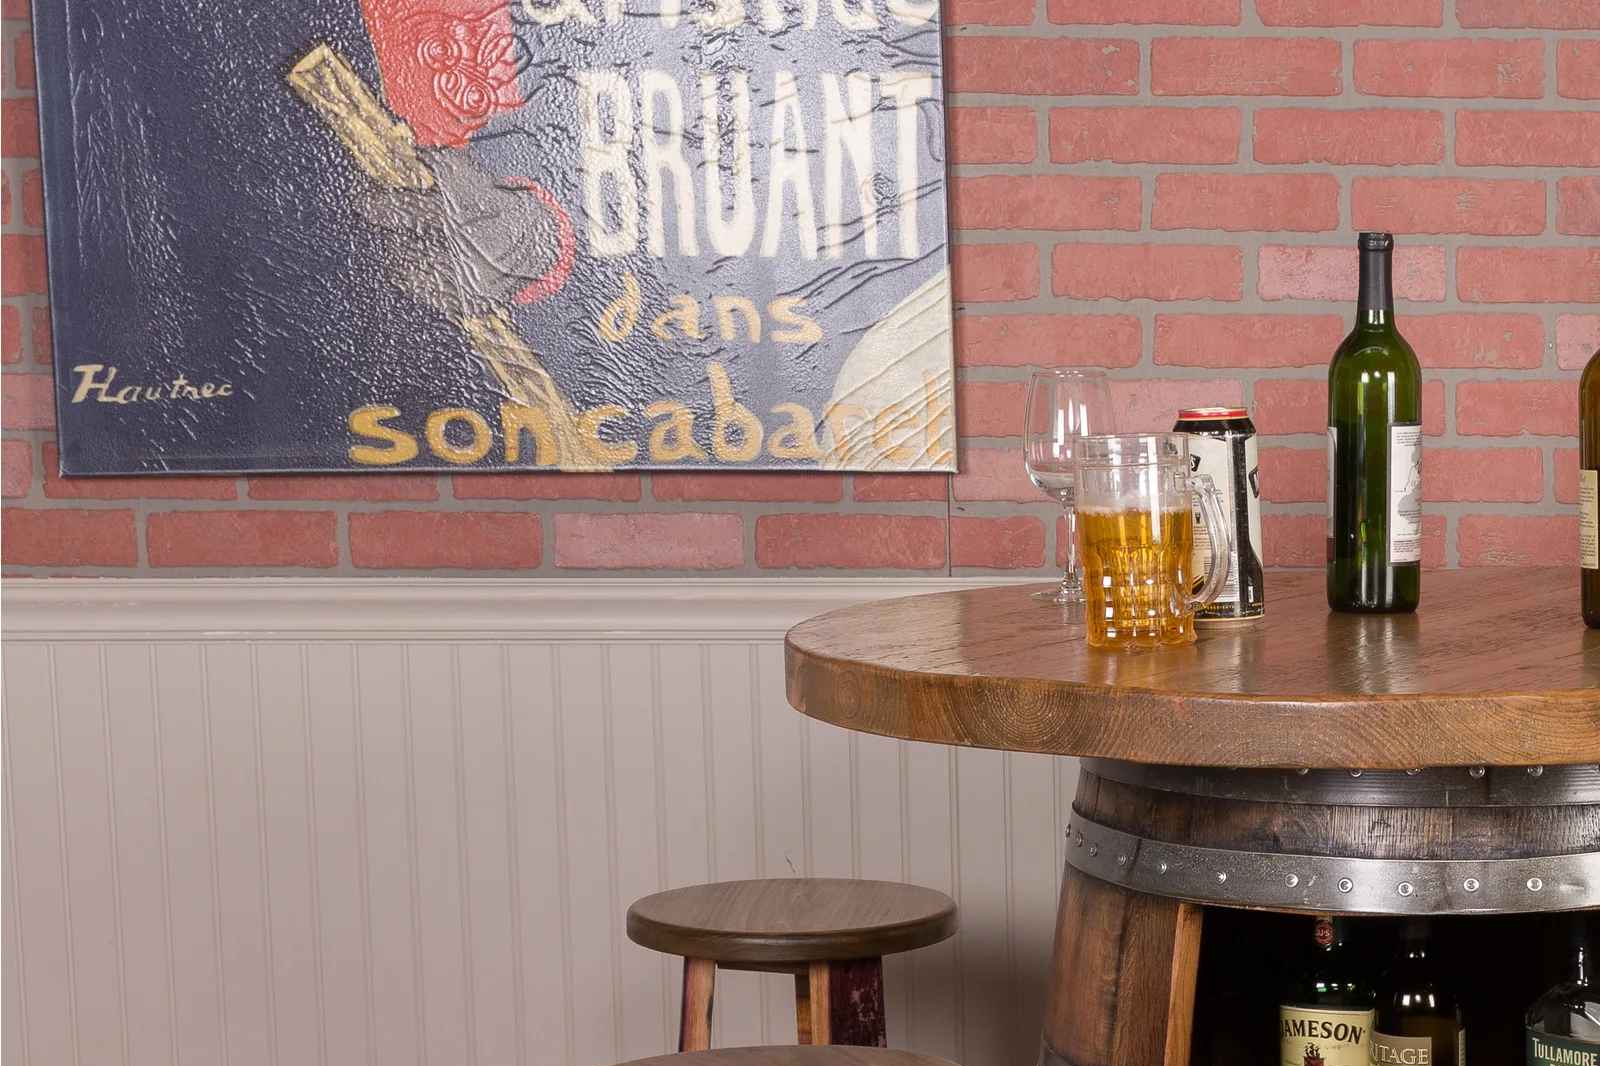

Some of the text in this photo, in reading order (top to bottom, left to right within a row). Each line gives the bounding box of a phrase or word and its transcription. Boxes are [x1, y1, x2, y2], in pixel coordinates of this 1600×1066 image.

[576, 69, 932, 259] BRUANT
[600, 272, 823, 344] dans
[347, 403, 561, 466] son
